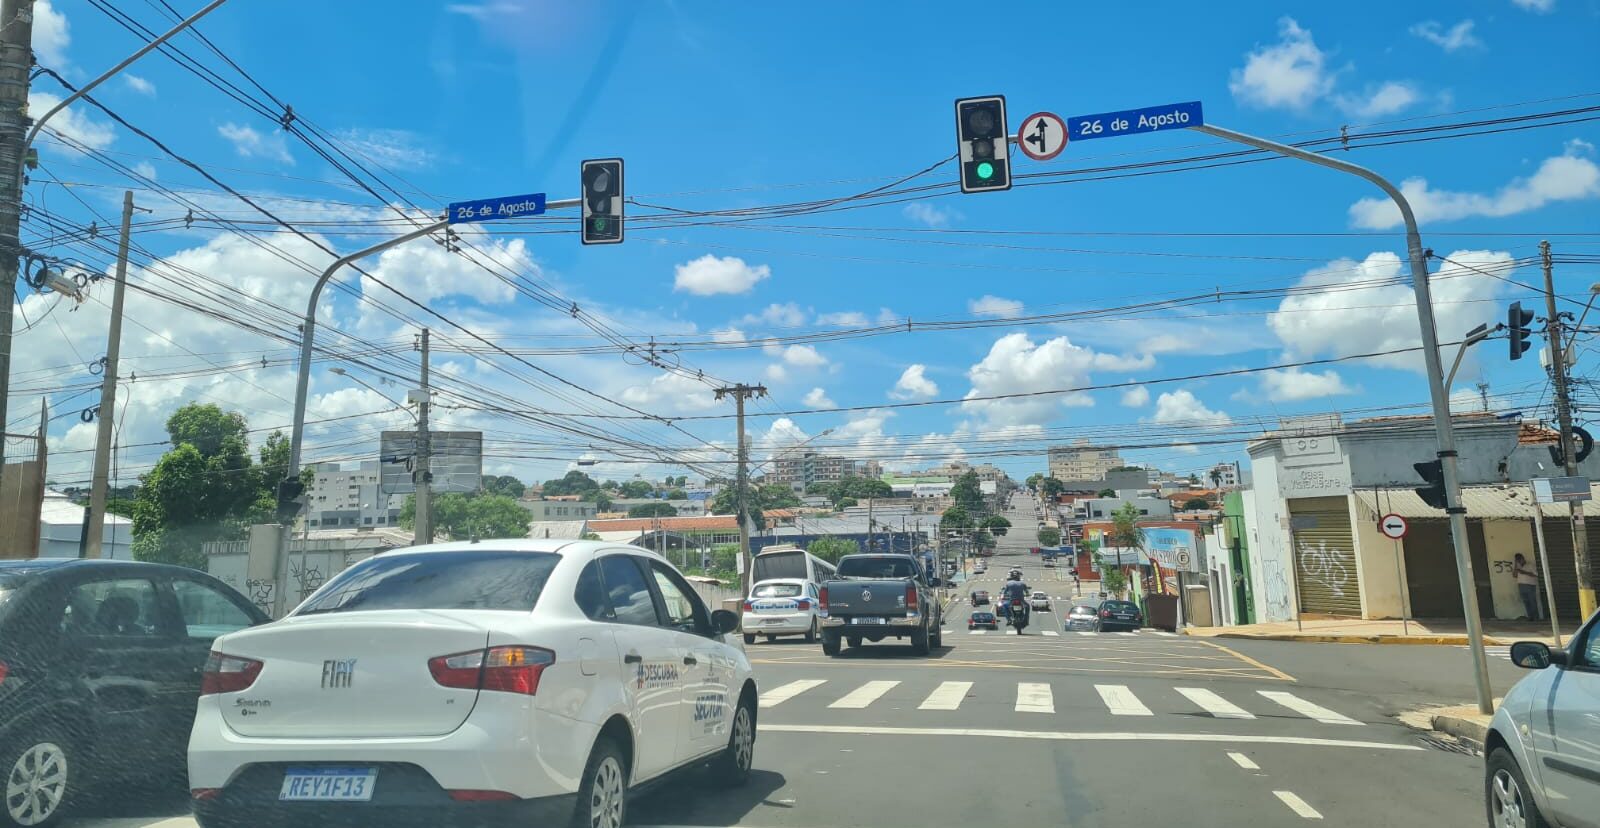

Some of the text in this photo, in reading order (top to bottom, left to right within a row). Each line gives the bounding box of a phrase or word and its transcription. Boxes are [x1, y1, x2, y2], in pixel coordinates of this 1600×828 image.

[1080, 110, 1190, 135] 26 de Agosto
[457, 200, 536, 218] 26 de Agosto
[321, 659, 357, 689] FIAT
[694, 694, 725, 722] SECTUR
[289, 777, 366, 797] REY1F13
